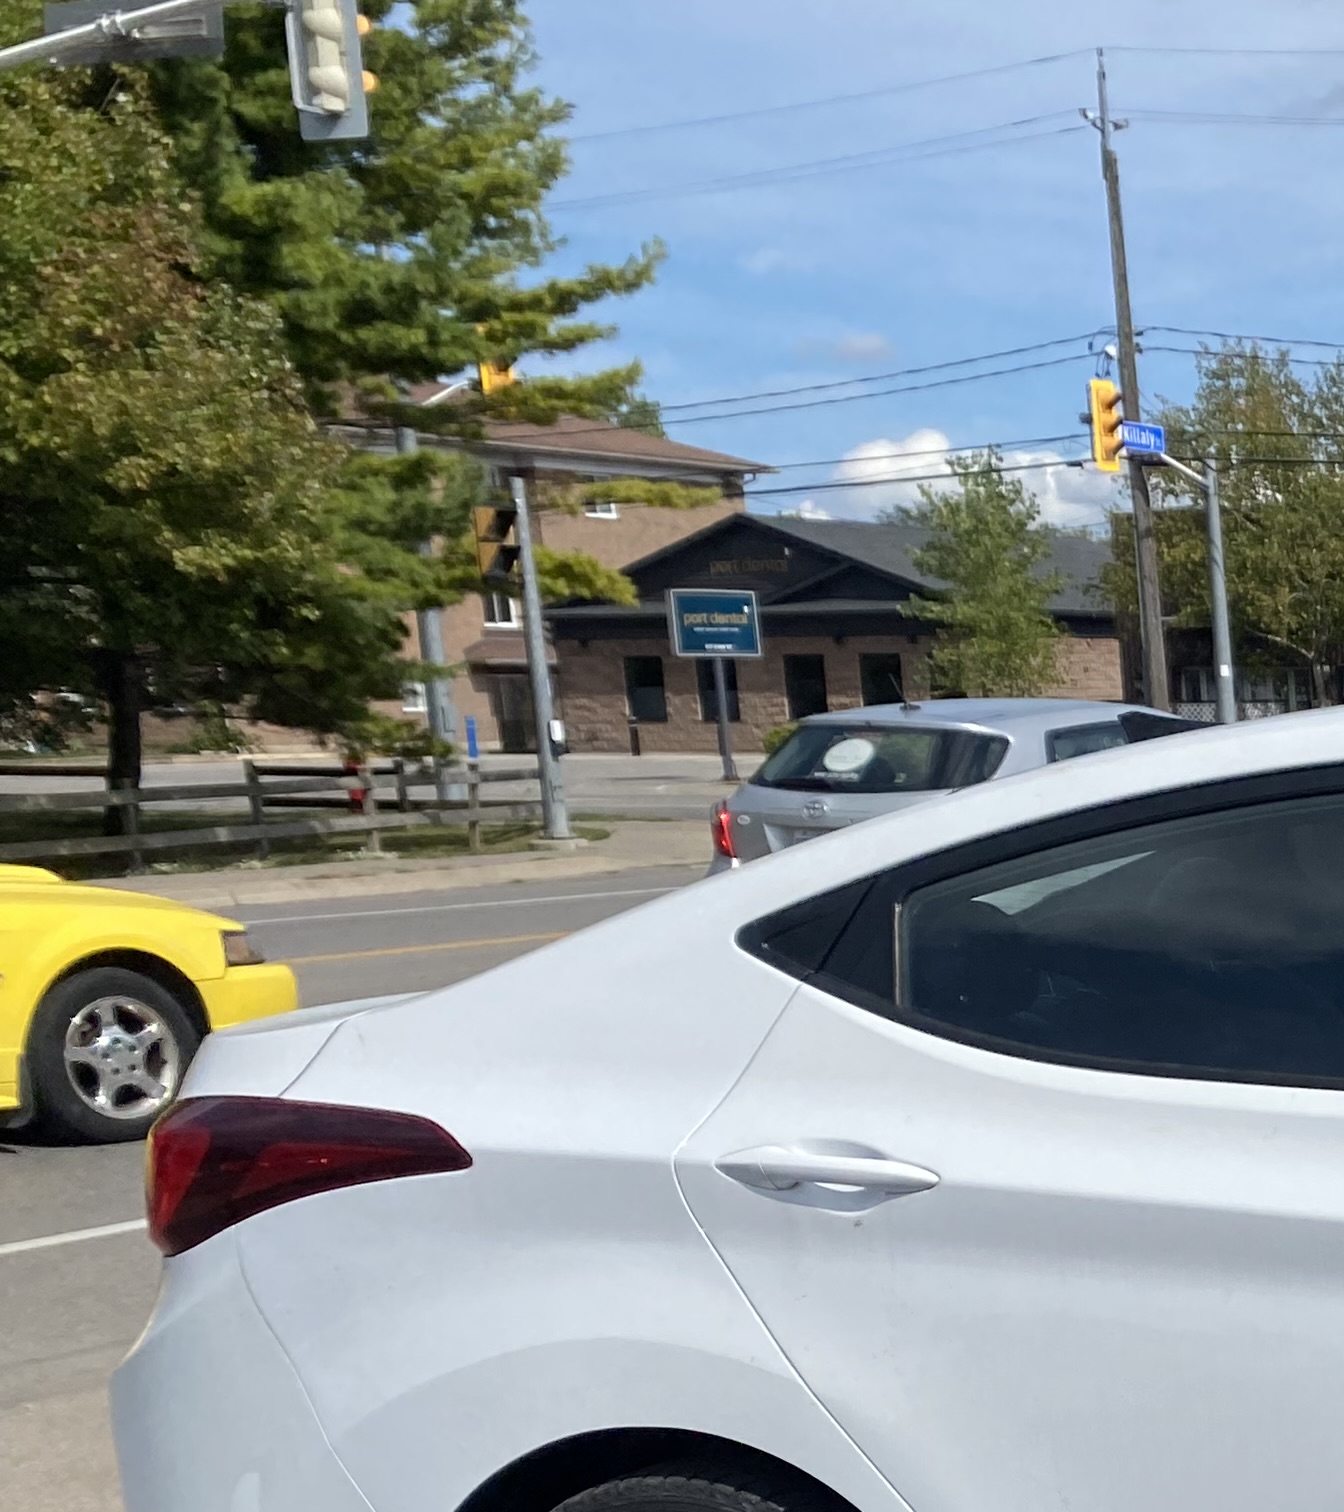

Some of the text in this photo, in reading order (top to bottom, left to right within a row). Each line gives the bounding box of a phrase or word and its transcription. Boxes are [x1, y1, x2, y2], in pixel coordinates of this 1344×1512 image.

[1123, 426, 1155, 450] Killaly
[684, 610, 748, 628] port dental
